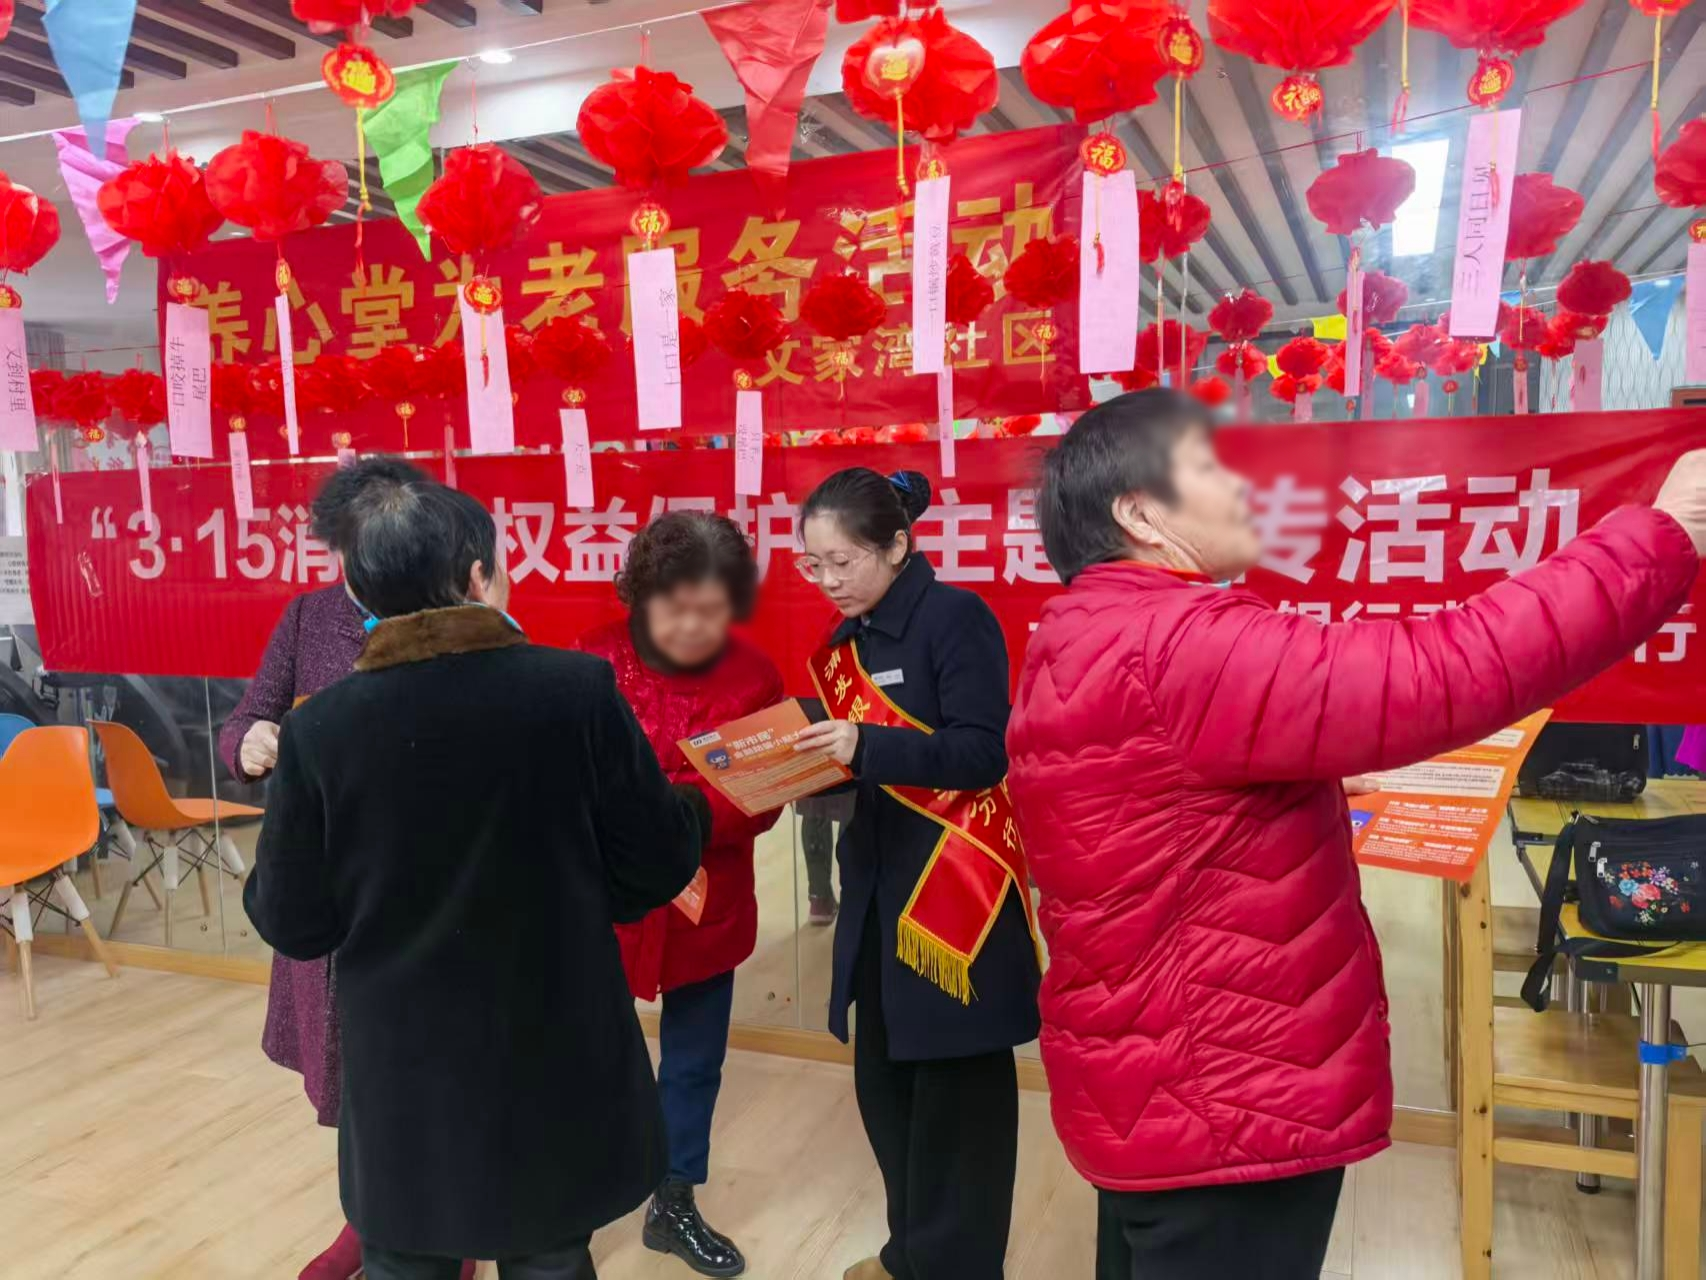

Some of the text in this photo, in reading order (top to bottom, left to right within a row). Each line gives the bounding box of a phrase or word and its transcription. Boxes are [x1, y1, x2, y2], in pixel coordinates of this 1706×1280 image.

[1090, 142, 1115, 169] 福
[639, 210, 661, 233] 福
[6, 348, 27, 412] 又到村里
